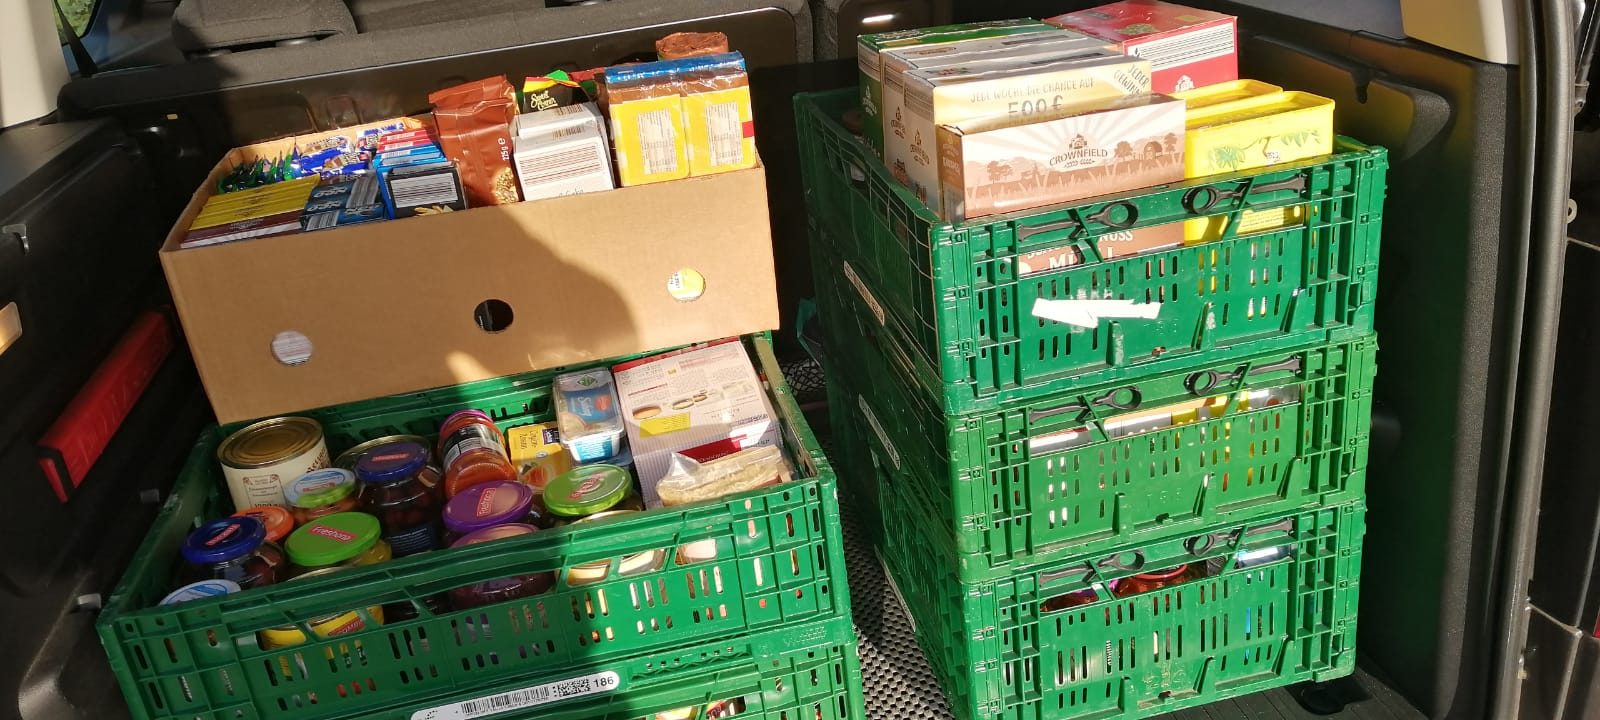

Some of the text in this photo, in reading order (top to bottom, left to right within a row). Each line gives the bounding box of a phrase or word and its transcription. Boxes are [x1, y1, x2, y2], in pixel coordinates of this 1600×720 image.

[1127, 64, 1150, 88] JEDER
[1043, 79, 1077, 94] CHANCE
[1049, 148, 1108, 166] CROWNFIELD
[309, 524, 353, 542] Freshona
[593, 676, 615, 688] 186
